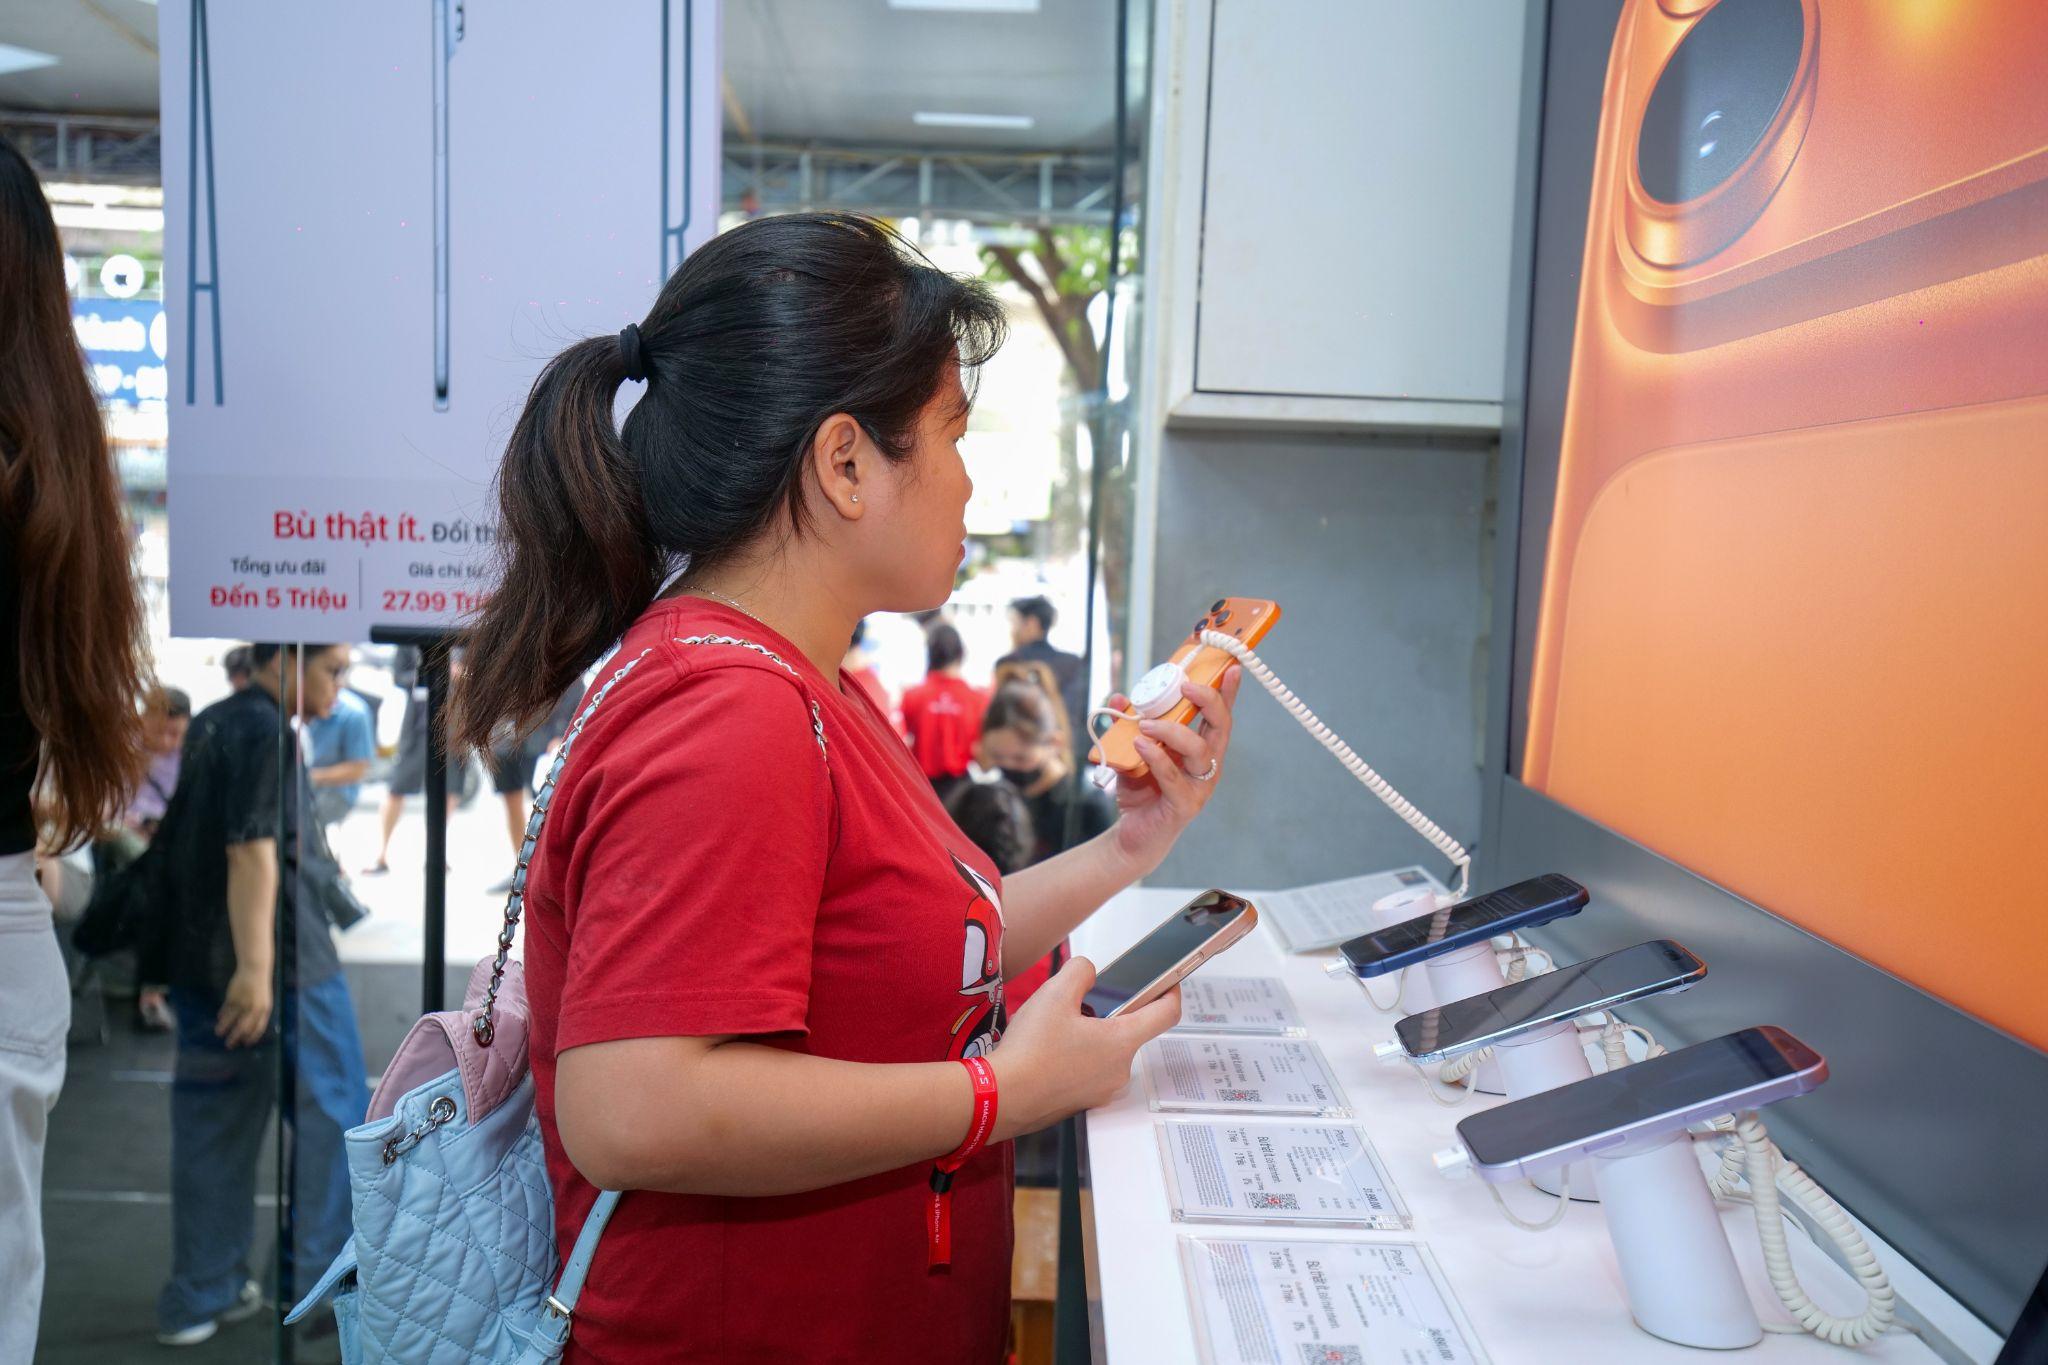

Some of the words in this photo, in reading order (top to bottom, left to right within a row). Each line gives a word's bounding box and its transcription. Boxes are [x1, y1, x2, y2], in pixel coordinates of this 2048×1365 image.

[273, 509, 316, 540] Bù
[325, 511, 389, 549] thật
[398, 512, 426, 541] ít.
[274, 560, 298, 574] ưu
[301, 558, 327, 574] đãi
[408, 562, 434, 578] Giá
[210, 583, 259, 608] Đến
[266, 587, 281, 608] 5
[287, 586, 348, 613] Triệu
[383, 589, 446, 613] 27.99
